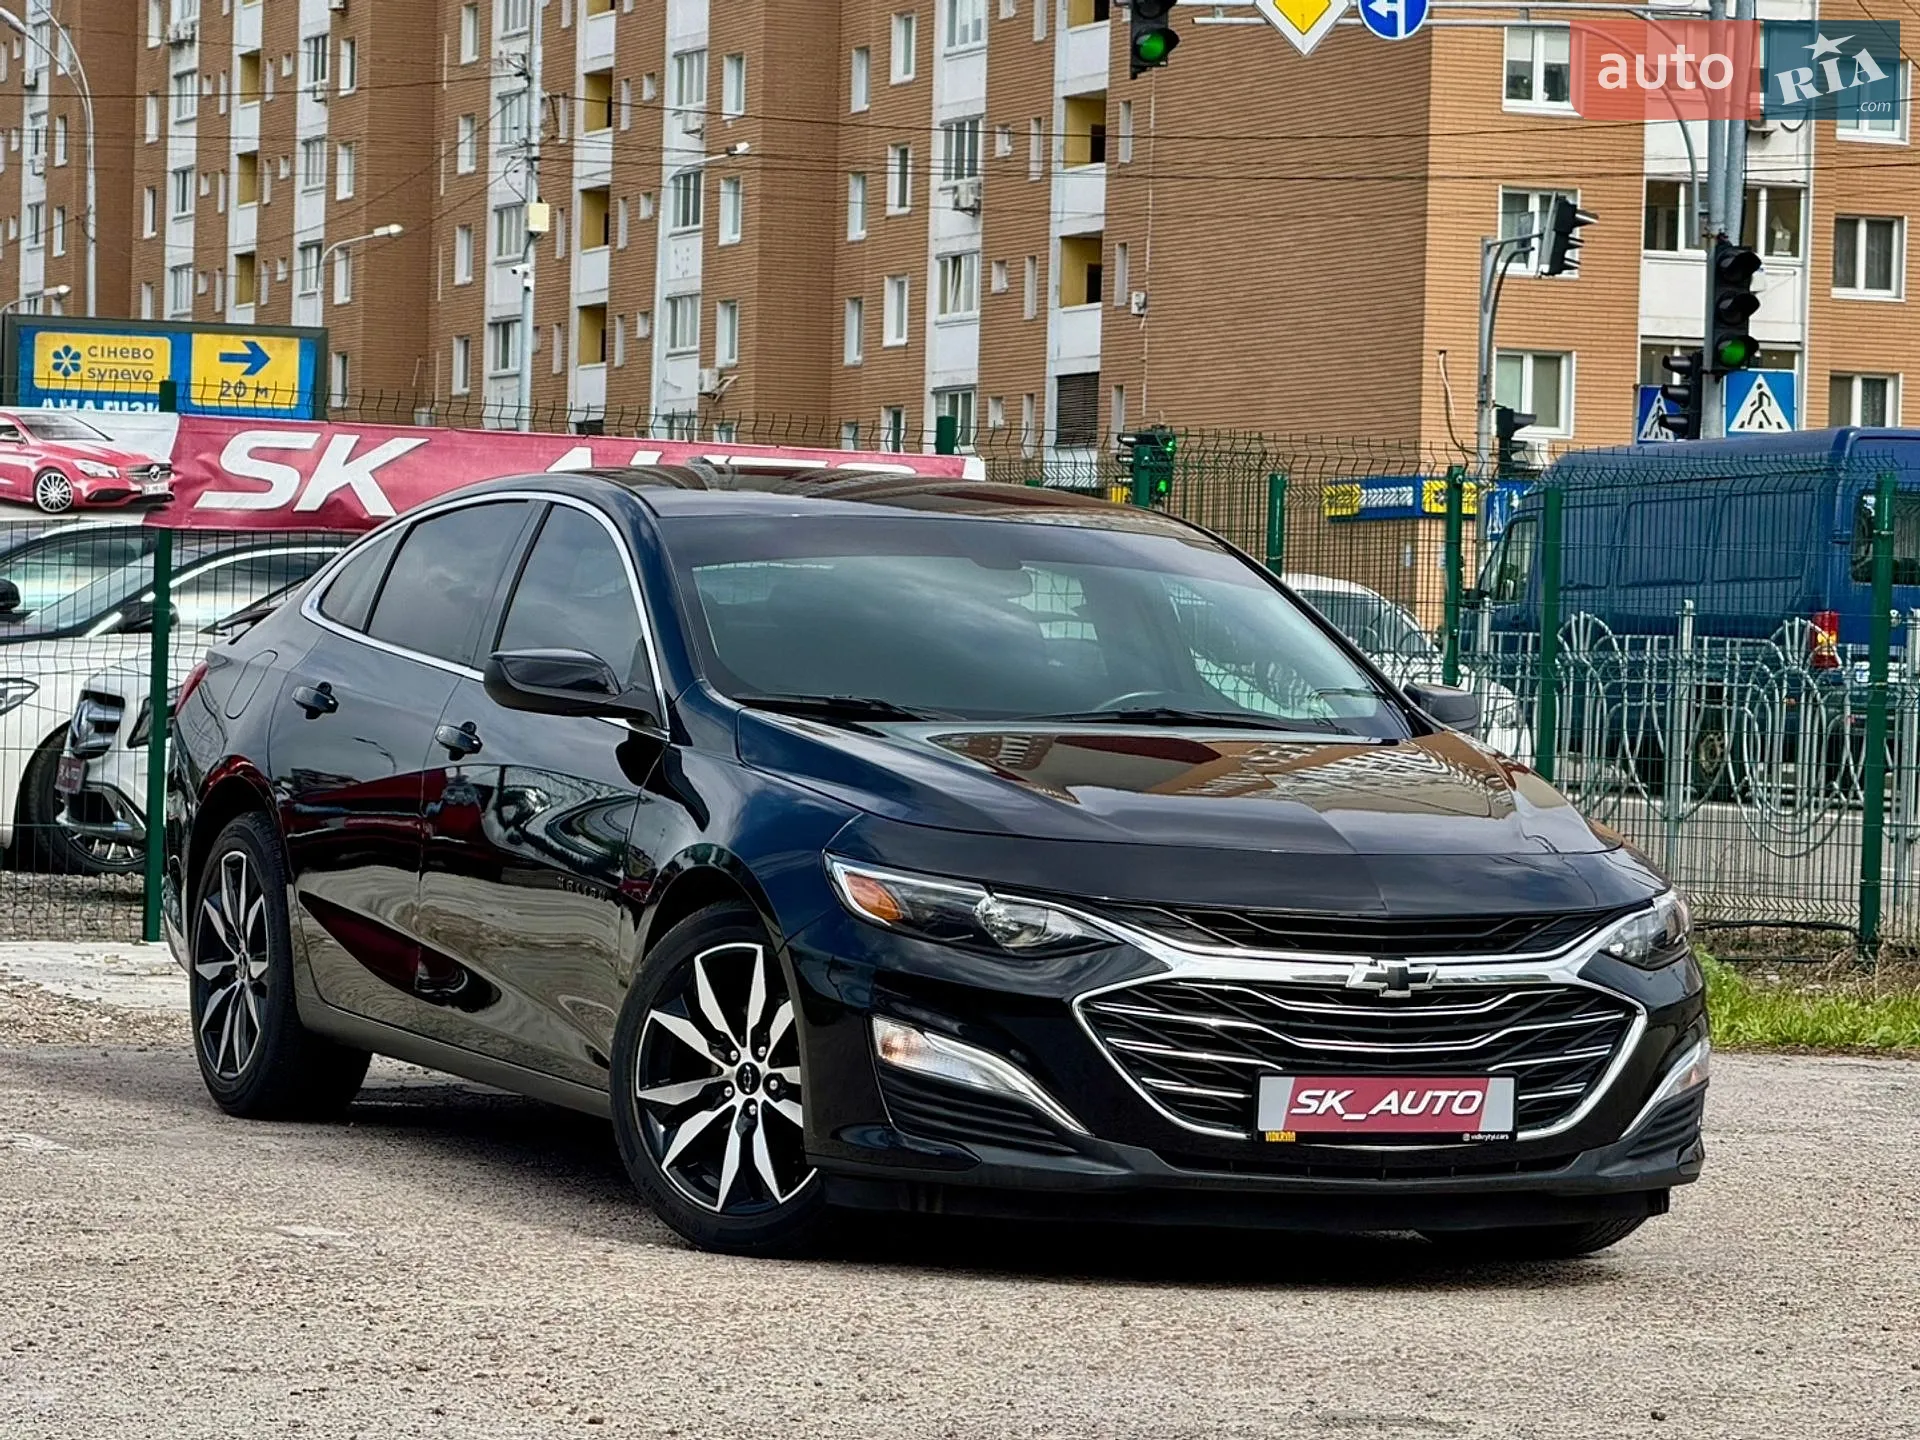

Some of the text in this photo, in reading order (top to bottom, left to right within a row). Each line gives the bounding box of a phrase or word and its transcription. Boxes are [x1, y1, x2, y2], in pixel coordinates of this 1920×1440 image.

[87, 367, 154, 383] synevo
[220, 380, 247, 398] 20
[194, 430, 429, 518] SK
[1290, 1090, 1483, 1121] SK_AUTO
